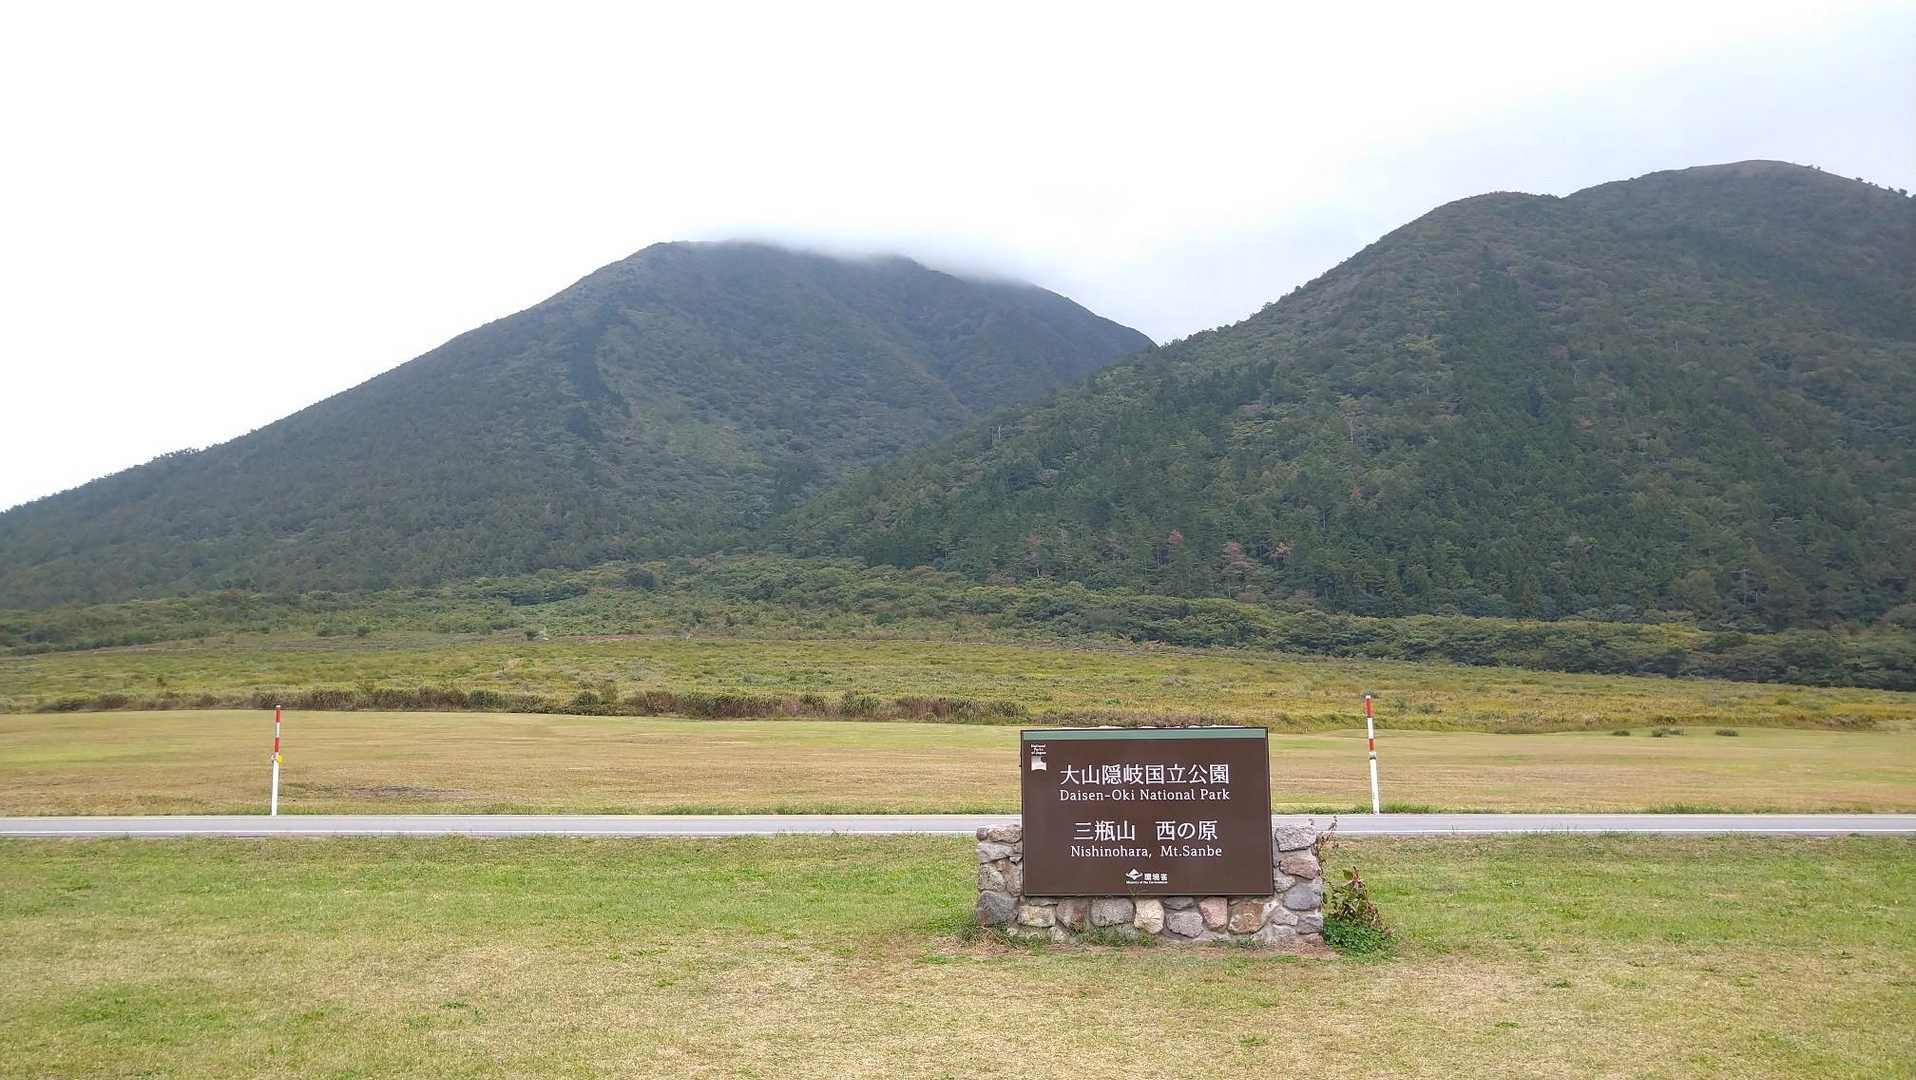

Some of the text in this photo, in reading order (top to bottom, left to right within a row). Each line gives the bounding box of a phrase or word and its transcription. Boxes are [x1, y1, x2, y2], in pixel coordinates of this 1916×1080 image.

[1060, 764, 1229, 785] 大山隠岐国立公園
[1060, 788, 1230, 801] Daisen-Oki National Park
[1074, 820, 1218, 841] 三瓶山 西の原
[1071, 844, 1222, 859] Nishinohara, Mt.Sanbe
